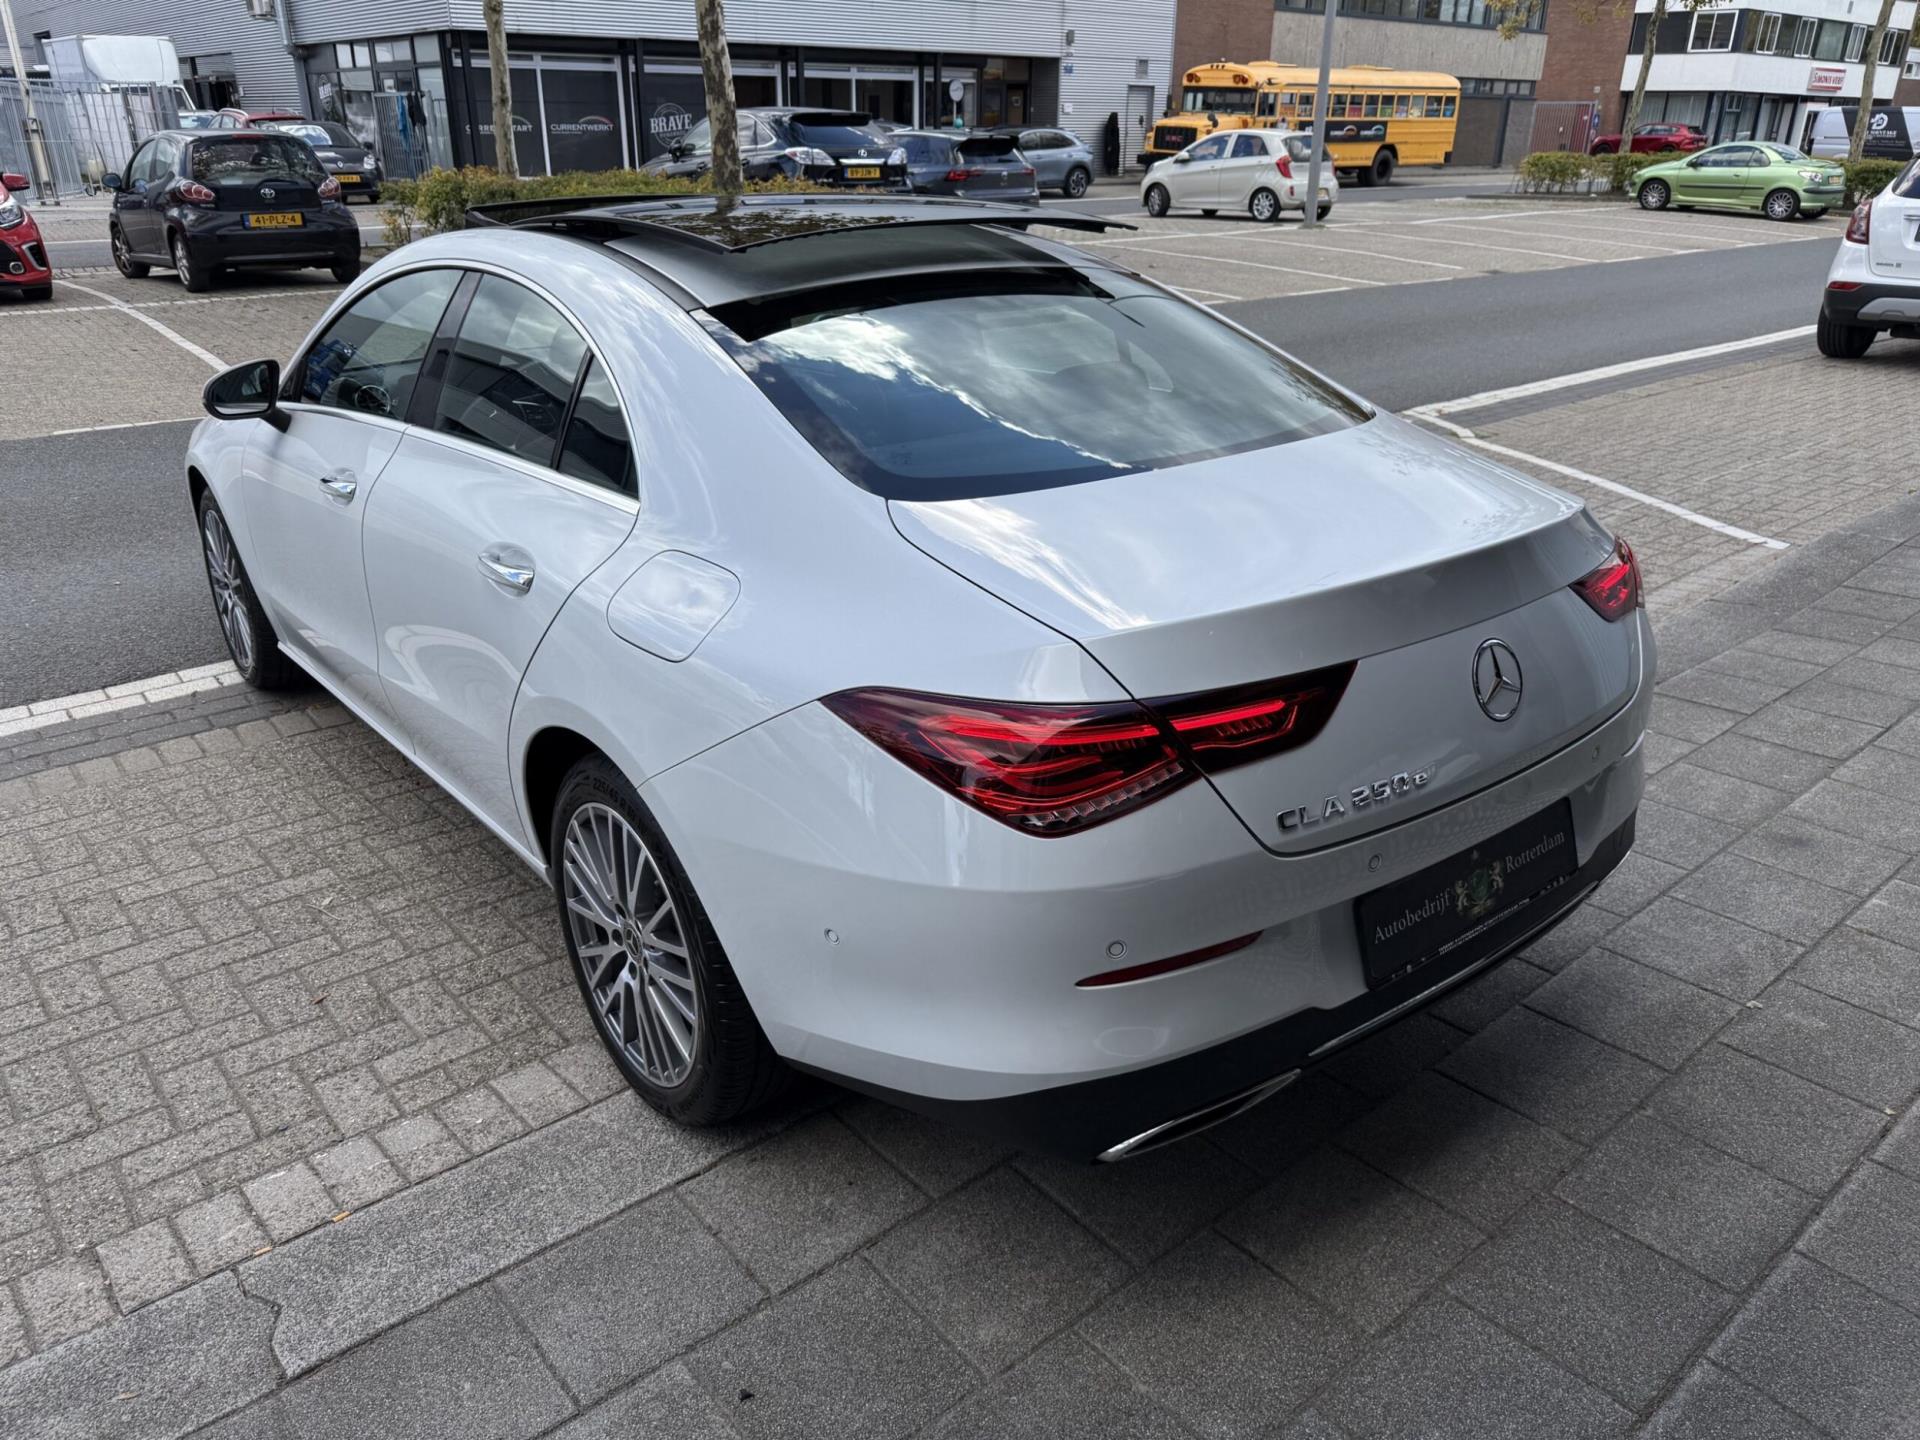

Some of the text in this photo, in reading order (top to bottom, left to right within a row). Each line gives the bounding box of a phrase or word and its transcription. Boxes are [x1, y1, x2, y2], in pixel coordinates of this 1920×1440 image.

[550, 123, 614, 132] CURRENTWERKT
[649, 113, 692, 133] BRAVE
[1276, 795, 1345, 831] CLA
[1374, 887, 1452, 945] Autobedrijf
[1505, 831, 1565, 874] Rotterdam
